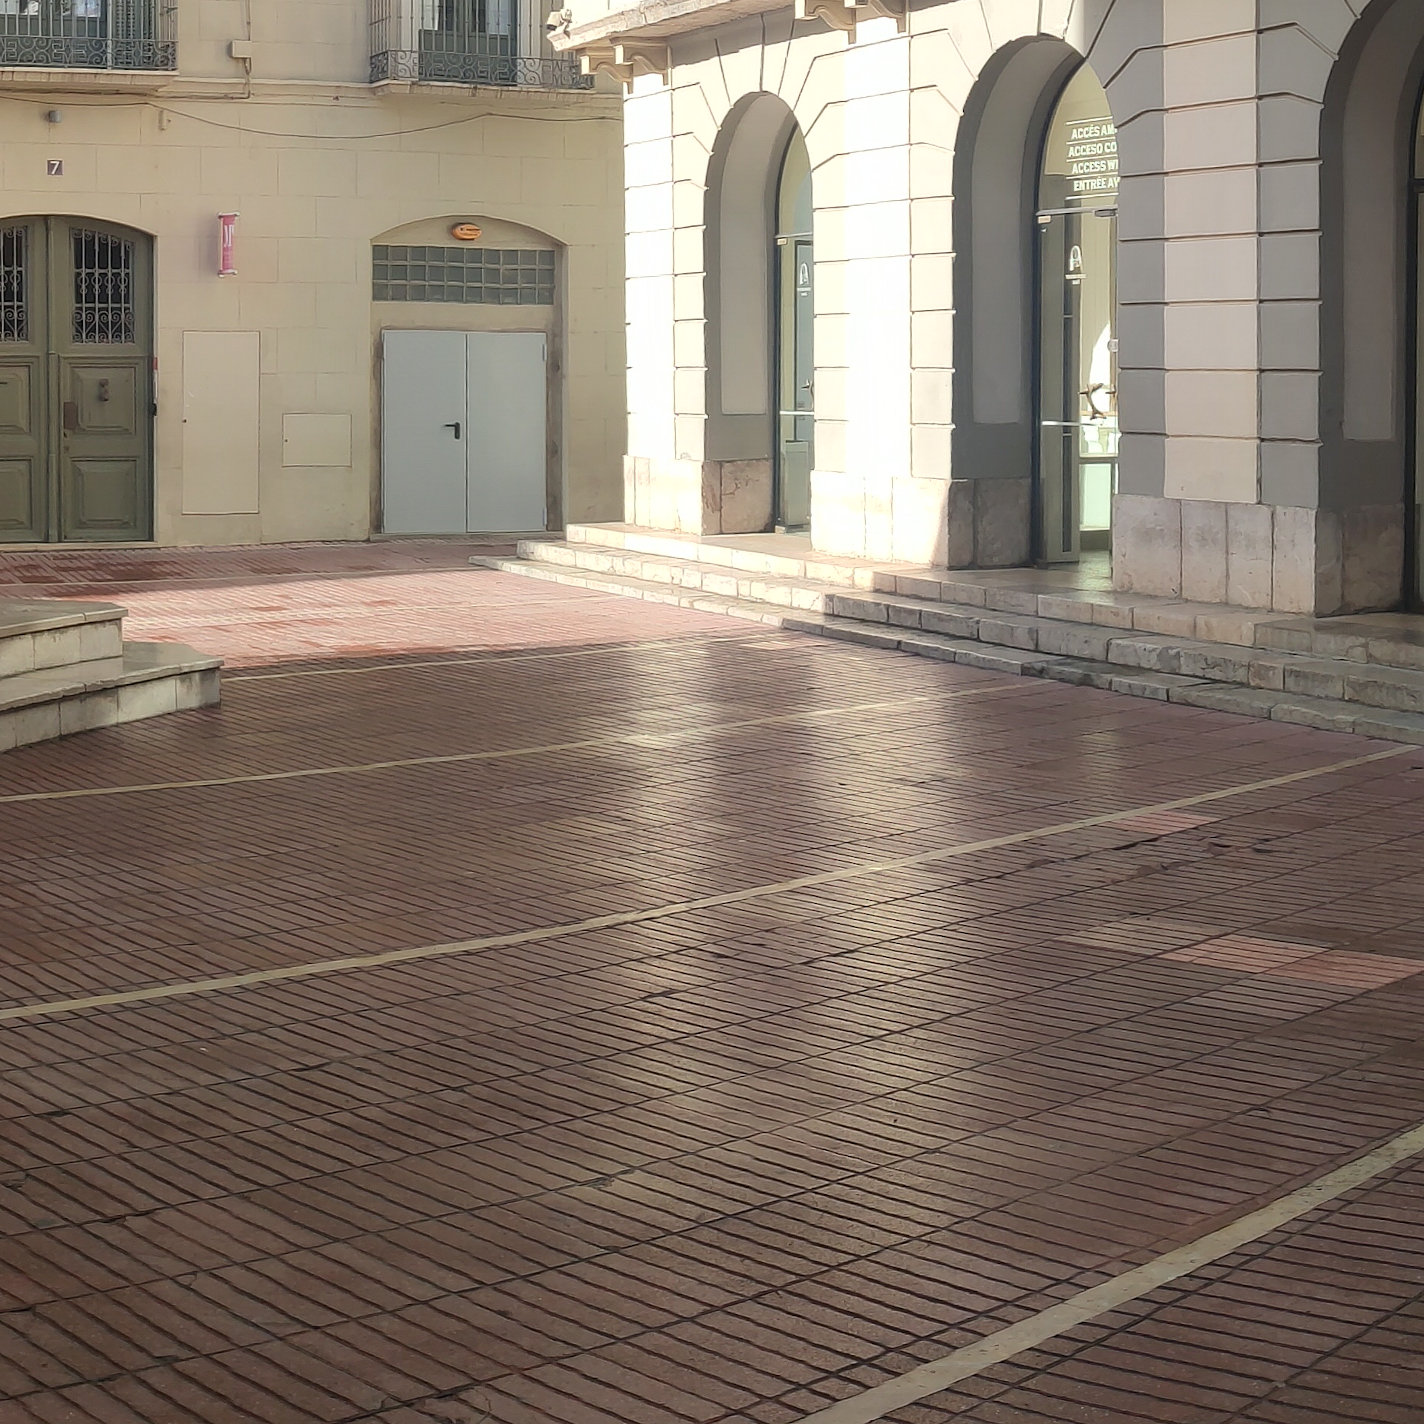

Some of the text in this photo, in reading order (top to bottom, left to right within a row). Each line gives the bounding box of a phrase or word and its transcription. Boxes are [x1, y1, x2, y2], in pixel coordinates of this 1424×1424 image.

[1068, 144, 1103, 157] ACCESO
[50, 161, 60, 175] 7
[1072, 161, 1106, 174] ACCESS
[1074, 177, 1107, 191] ENTRÉE
